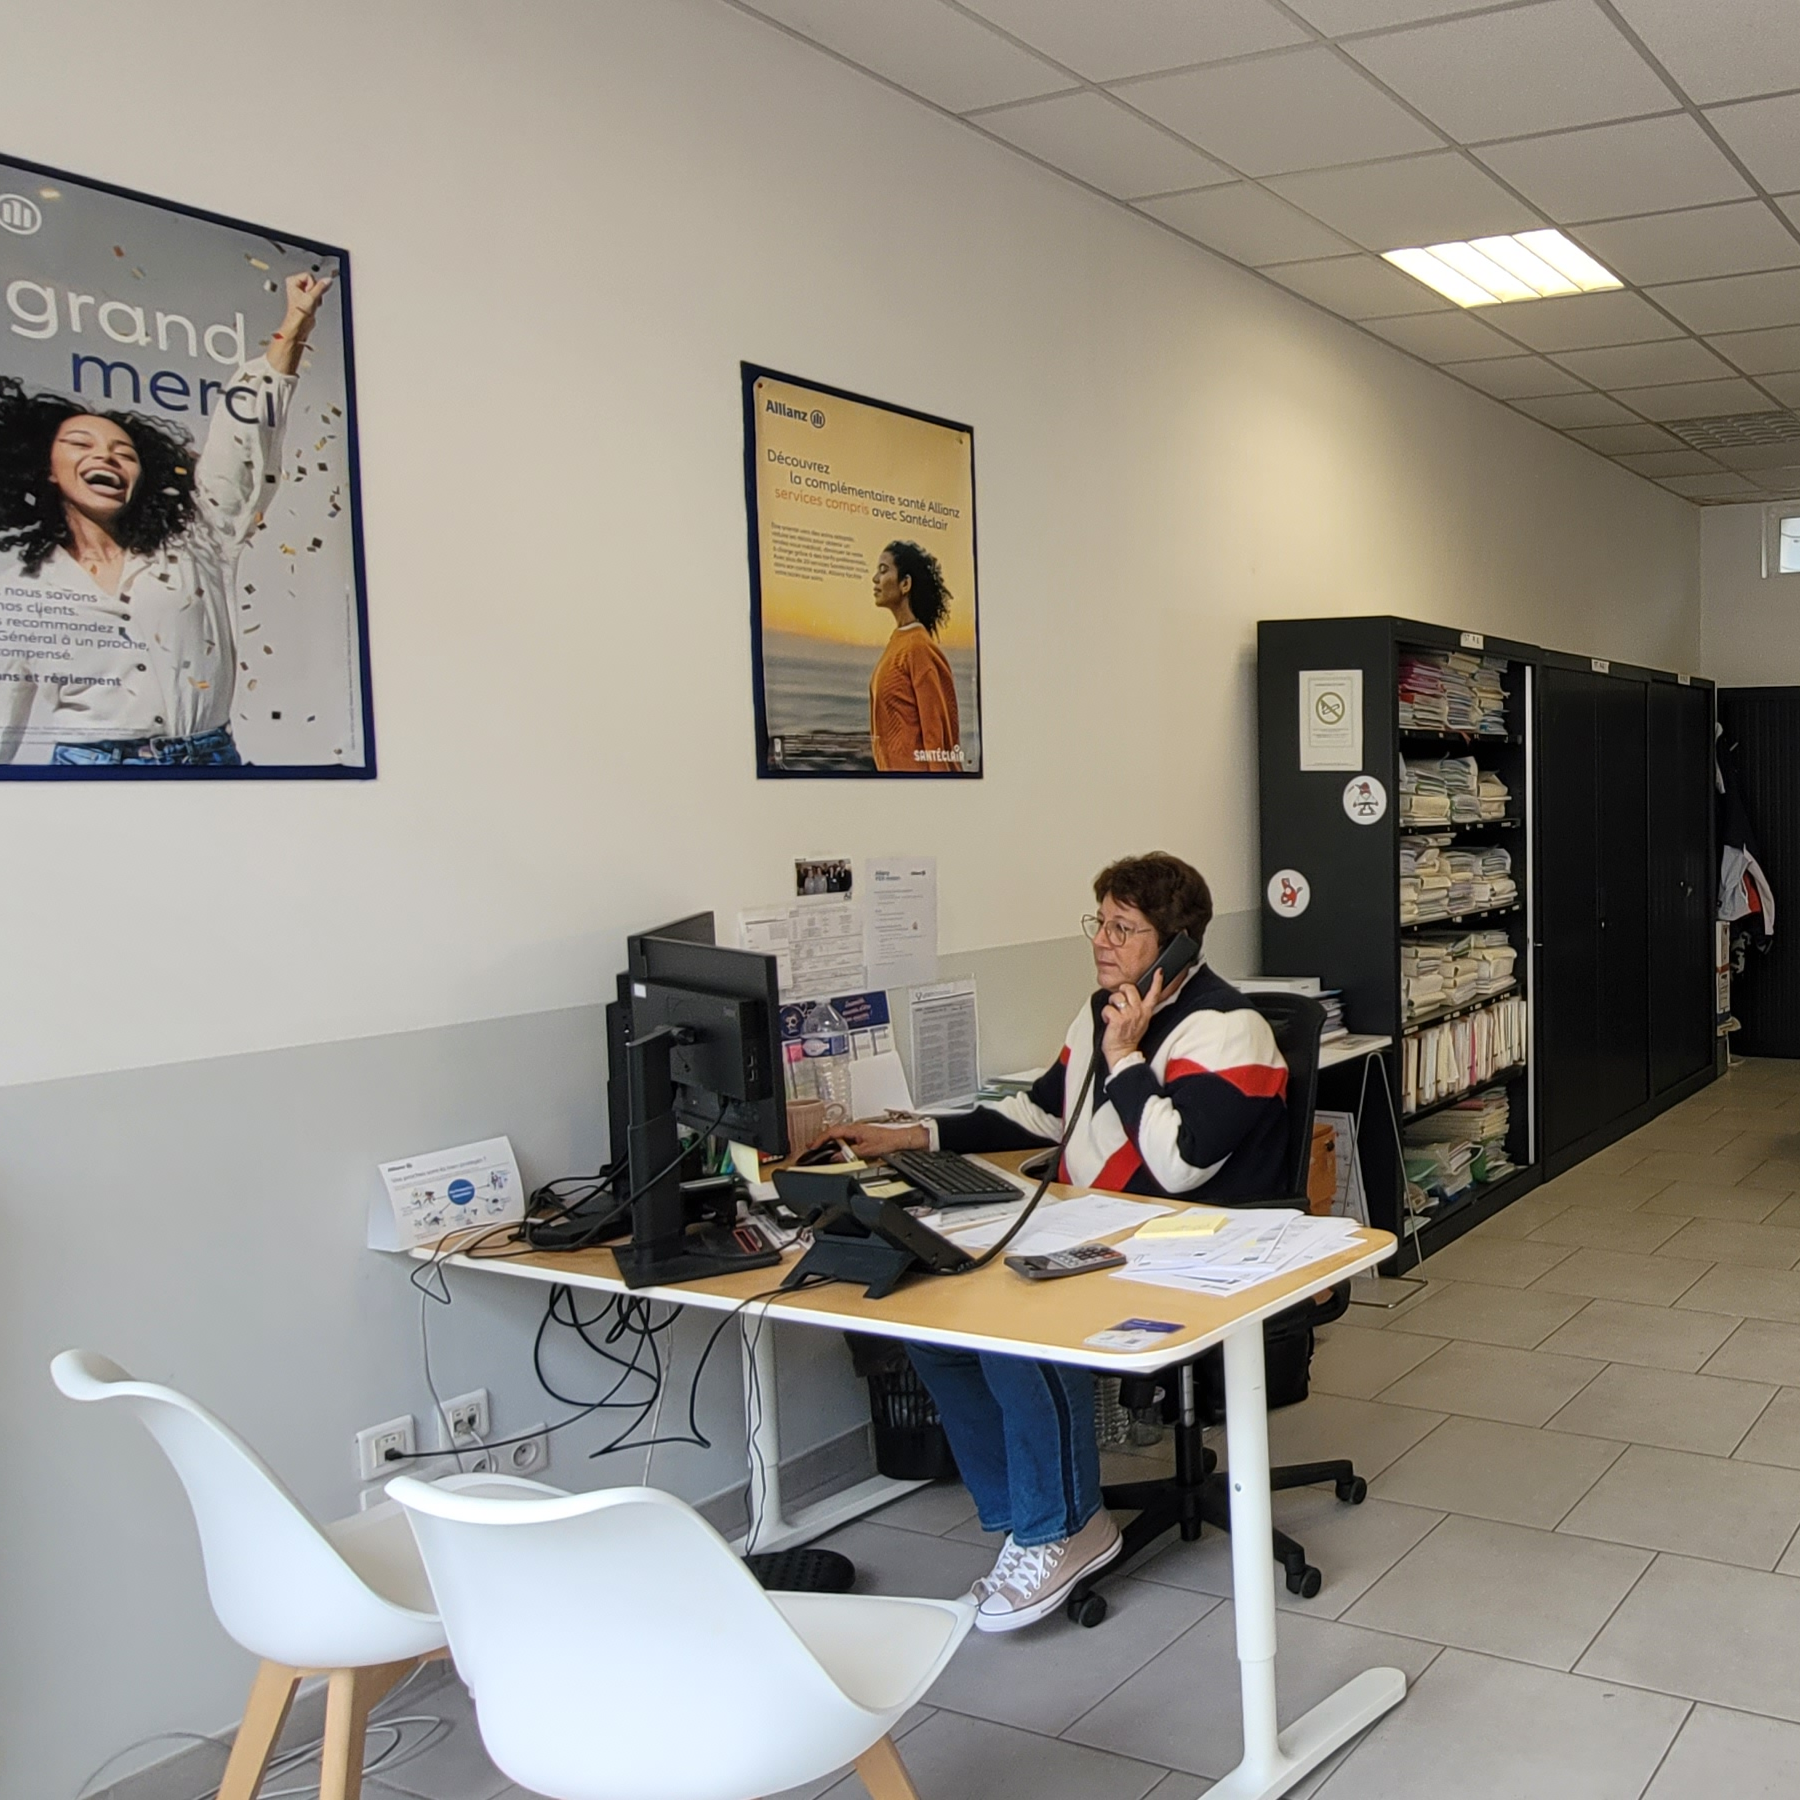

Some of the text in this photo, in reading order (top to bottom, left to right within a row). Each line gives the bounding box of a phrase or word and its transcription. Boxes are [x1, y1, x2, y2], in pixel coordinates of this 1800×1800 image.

[6, 280, 247, 366] grand
[72, 353, 276, 427] merci
[765, 399, 808, 422] Allianz
[767, 449, 830, 474] Découvrez
[790, 470, 960, 518] la complémentaire santé Allianz
[775, 488, 949, 531] services compris avec Santéclair
[5, 587, 42, 599] nous
[45, 590, 98, 603] savons
[27, 602, 79, 617] clients.
[6, 618, 114, 634] recommandez
[61, 634, 71, 646] à
[75, 638, 93, 647] un
[0, 647, 74, 661] ompensé.
[24, 673, 39, 683] et
